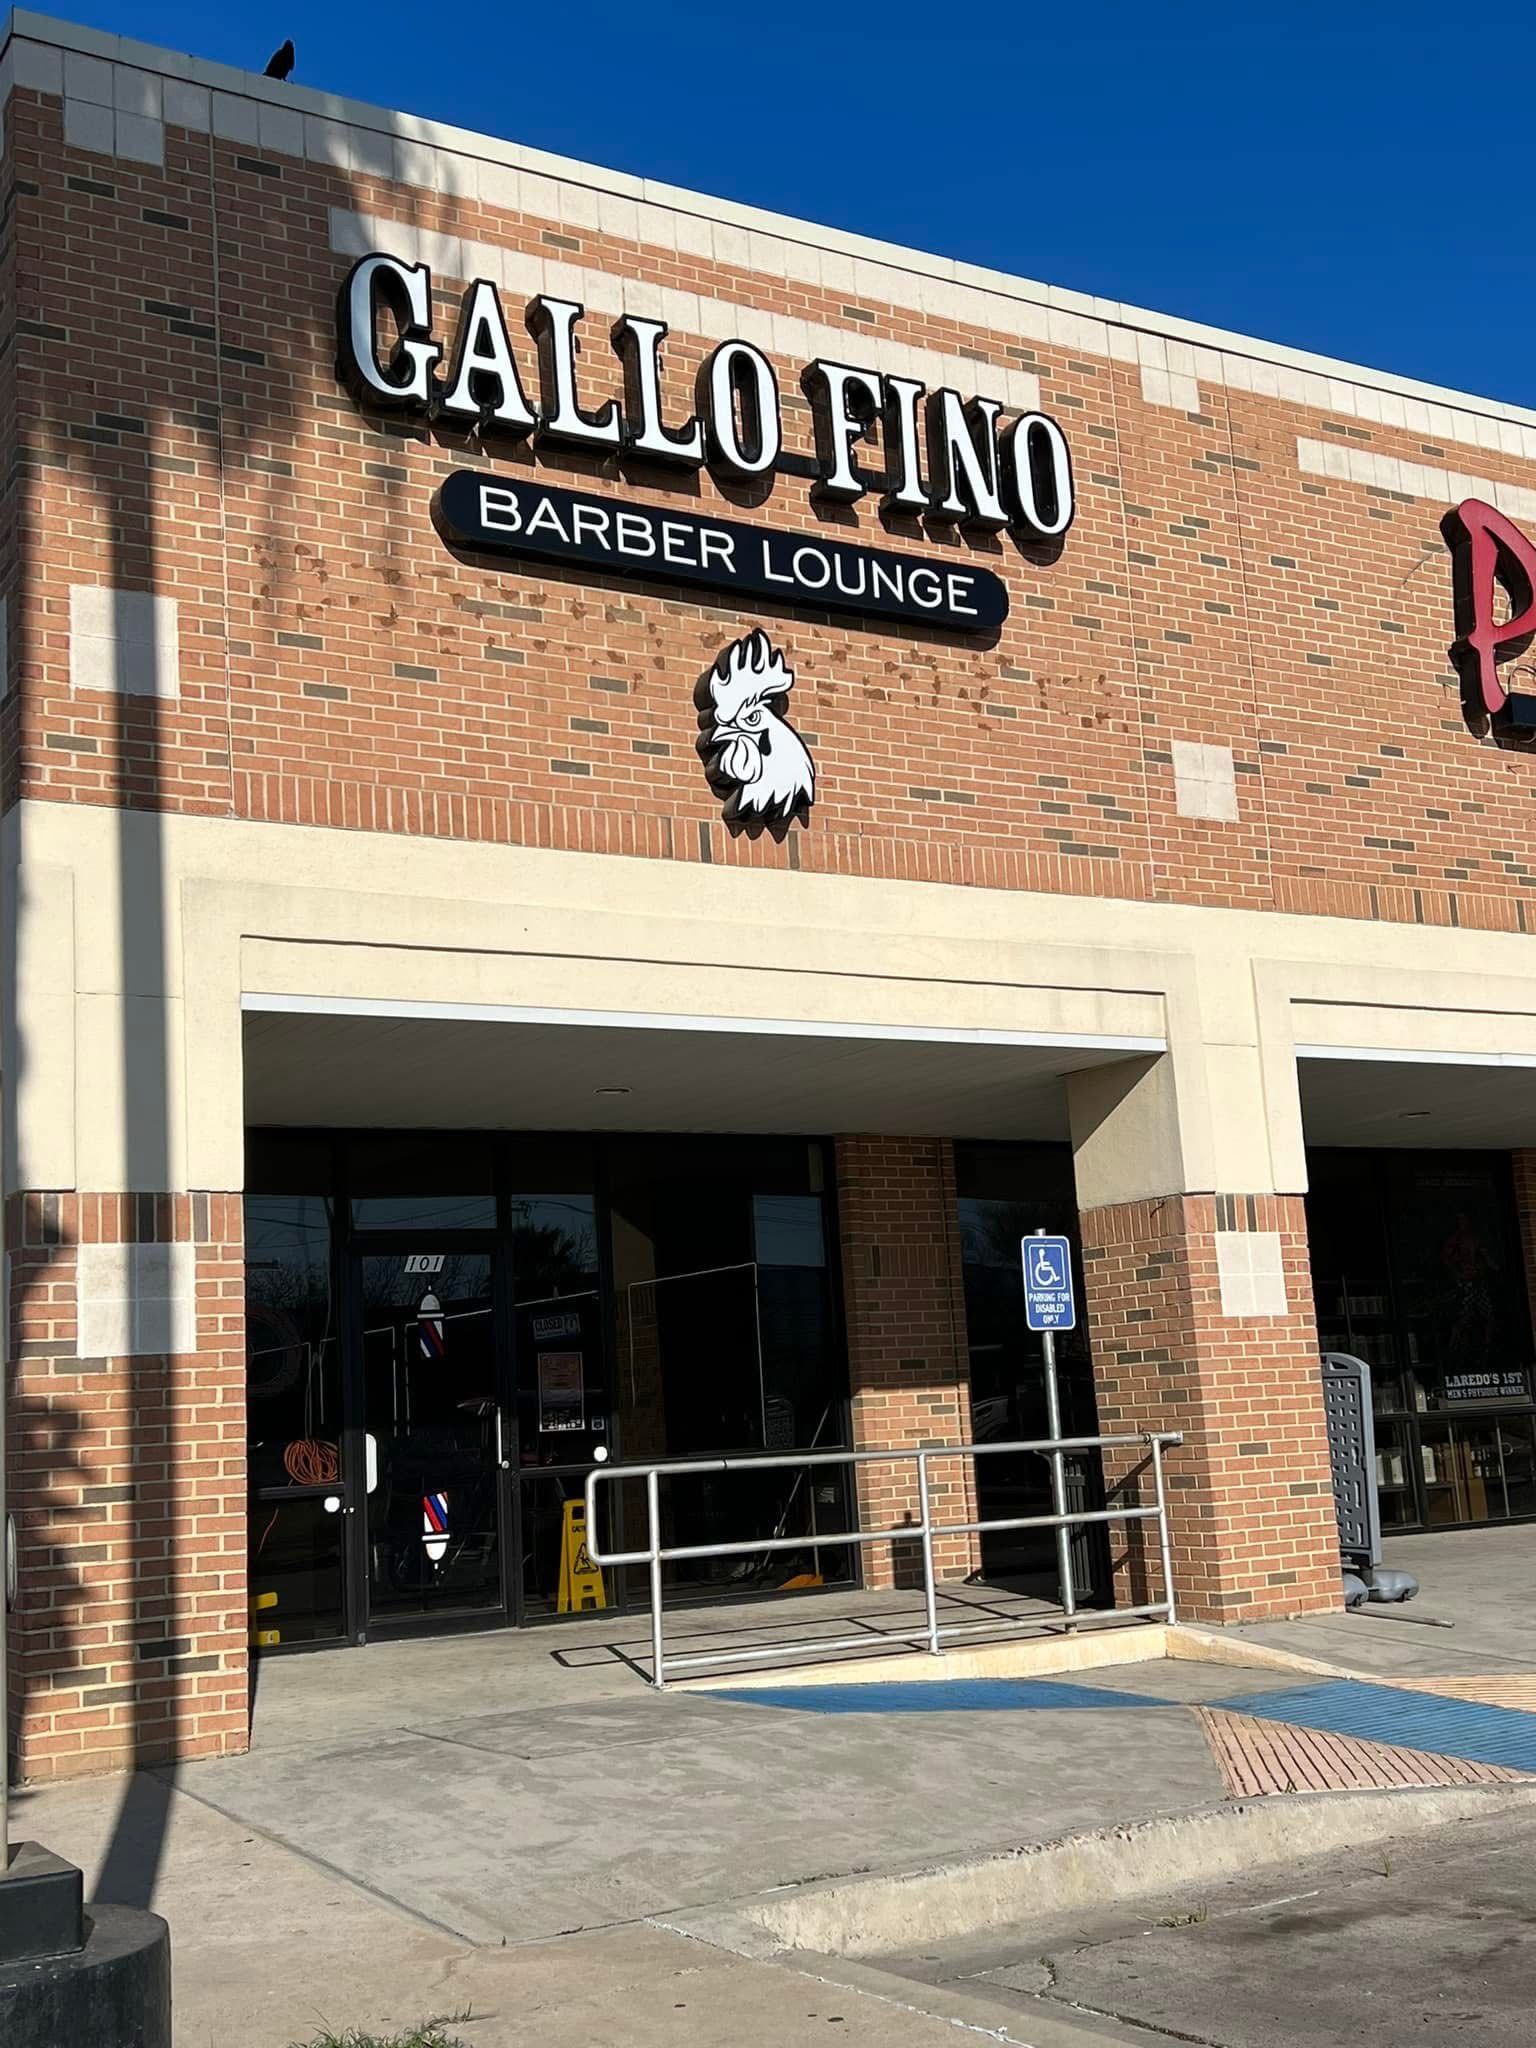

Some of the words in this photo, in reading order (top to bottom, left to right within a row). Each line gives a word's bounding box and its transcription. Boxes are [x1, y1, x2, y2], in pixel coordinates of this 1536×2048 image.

[343, 253, 781, 474] GALLO
[810, 359, 1075, 537] FINO
[478, 484, 737, 573] BARBER
[762, 534, 979, 615] LOUNGE
[409, 1256, 440, 1271] 101
[1029, 1292, 1056, 1302] PARKING
[1057, 1292, 1070, 1302] FOR
[1035, 1303, 1065, 1313] DISABLED
[1042, 1314, 1060, 1324] ONLY
[1445, 1373, 1500, 1388] LAREDO'S
[1502, 1371, 1523, 1384] 1ST
